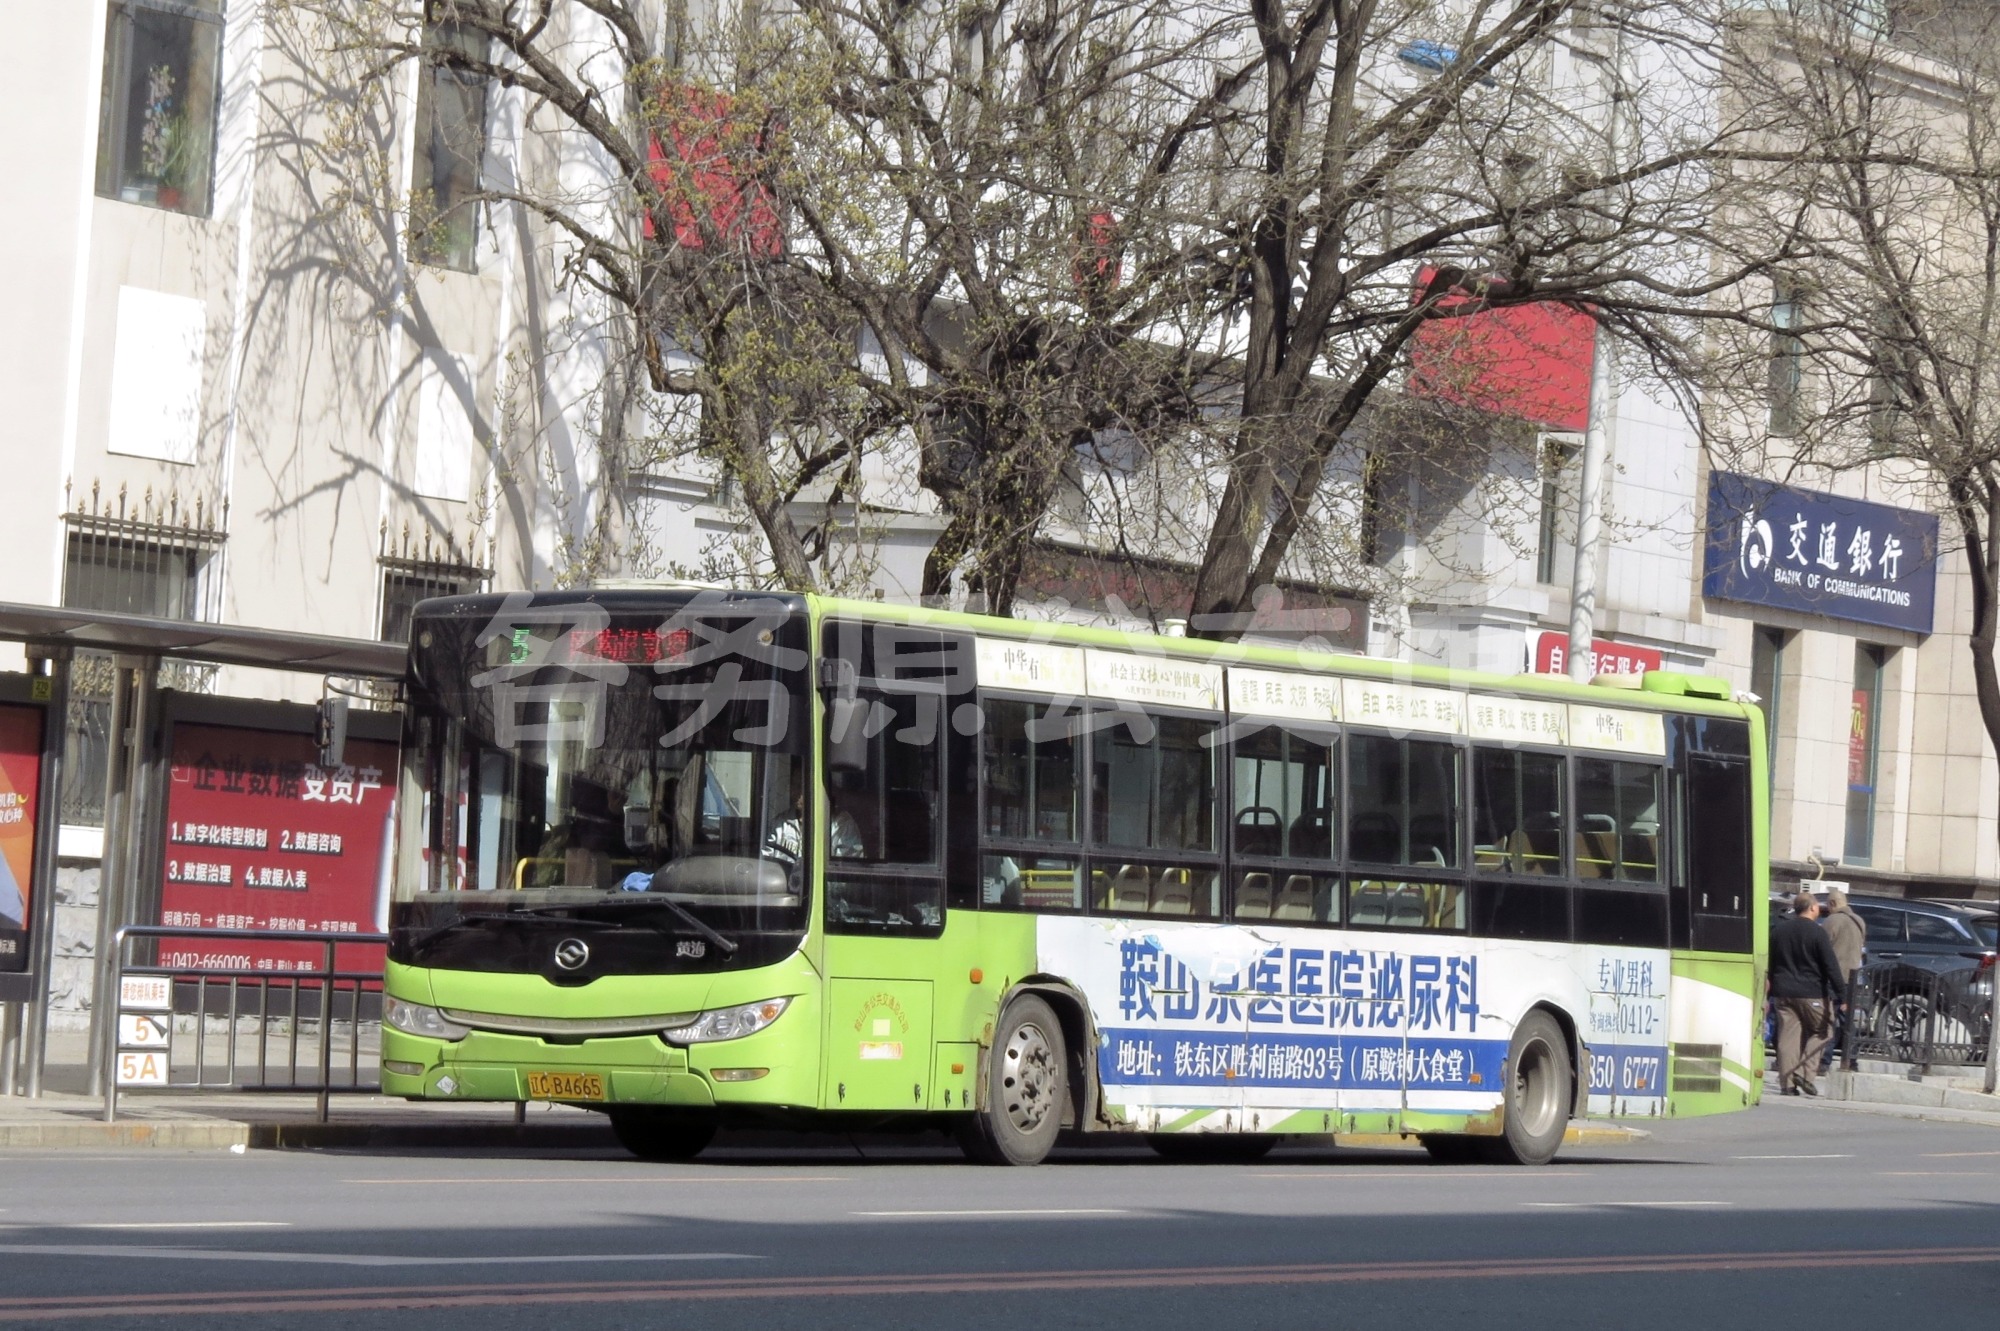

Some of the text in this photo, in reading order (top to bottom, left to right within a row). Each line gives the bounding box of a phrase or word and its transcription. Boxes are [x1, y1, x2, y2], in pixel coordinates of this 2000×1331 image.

[1786, 512, 1903, 582] 交通銀行
[1774, 567, 1911, 607] BANK OF COMMUNICATIONS
[510, 628, 531, 664] 5
[1110, 662, 1201, 689] 社会主义核心价值观
[1362, 690, 1380, 714] 自由
[171, 821, 342, 853] 1.数字化转型规划 2.数据咨询
[168, 859, 308, 889] 3.数据治理 4.数据入表
[163, 911, 201, 928] 明确方向
[1597, 958, 1653, 999] 专业男科
[135, 1016, 150, 1042] 5
[122, 1054, 159, 1080] 5A
[1623, 1055, 1659, 1091] 6777
